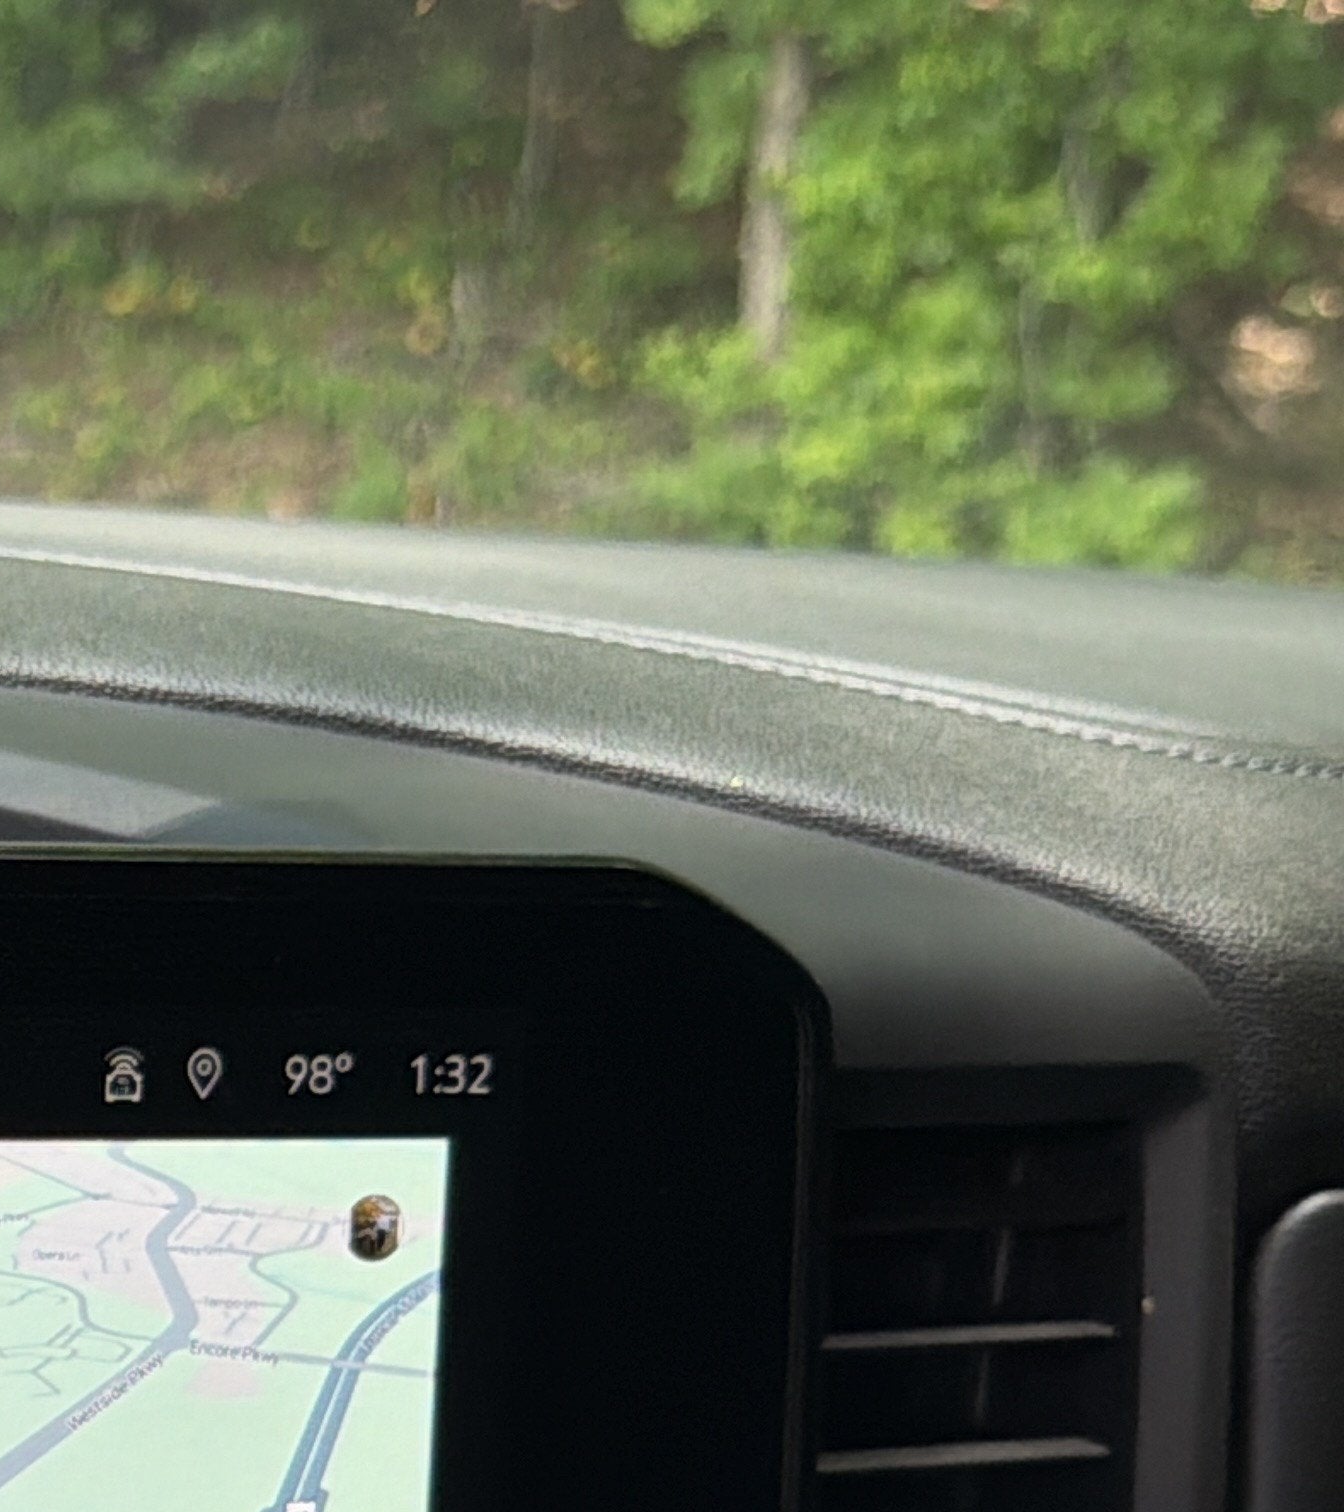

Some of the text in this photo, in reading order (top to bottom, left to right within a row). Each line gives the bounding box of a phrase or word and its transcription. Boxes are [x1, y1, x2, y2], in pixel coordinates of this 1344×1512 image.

[410, 1053, 495, 1096] 1:32
[68, 1354, 164, 1431] Westside Pkwy
